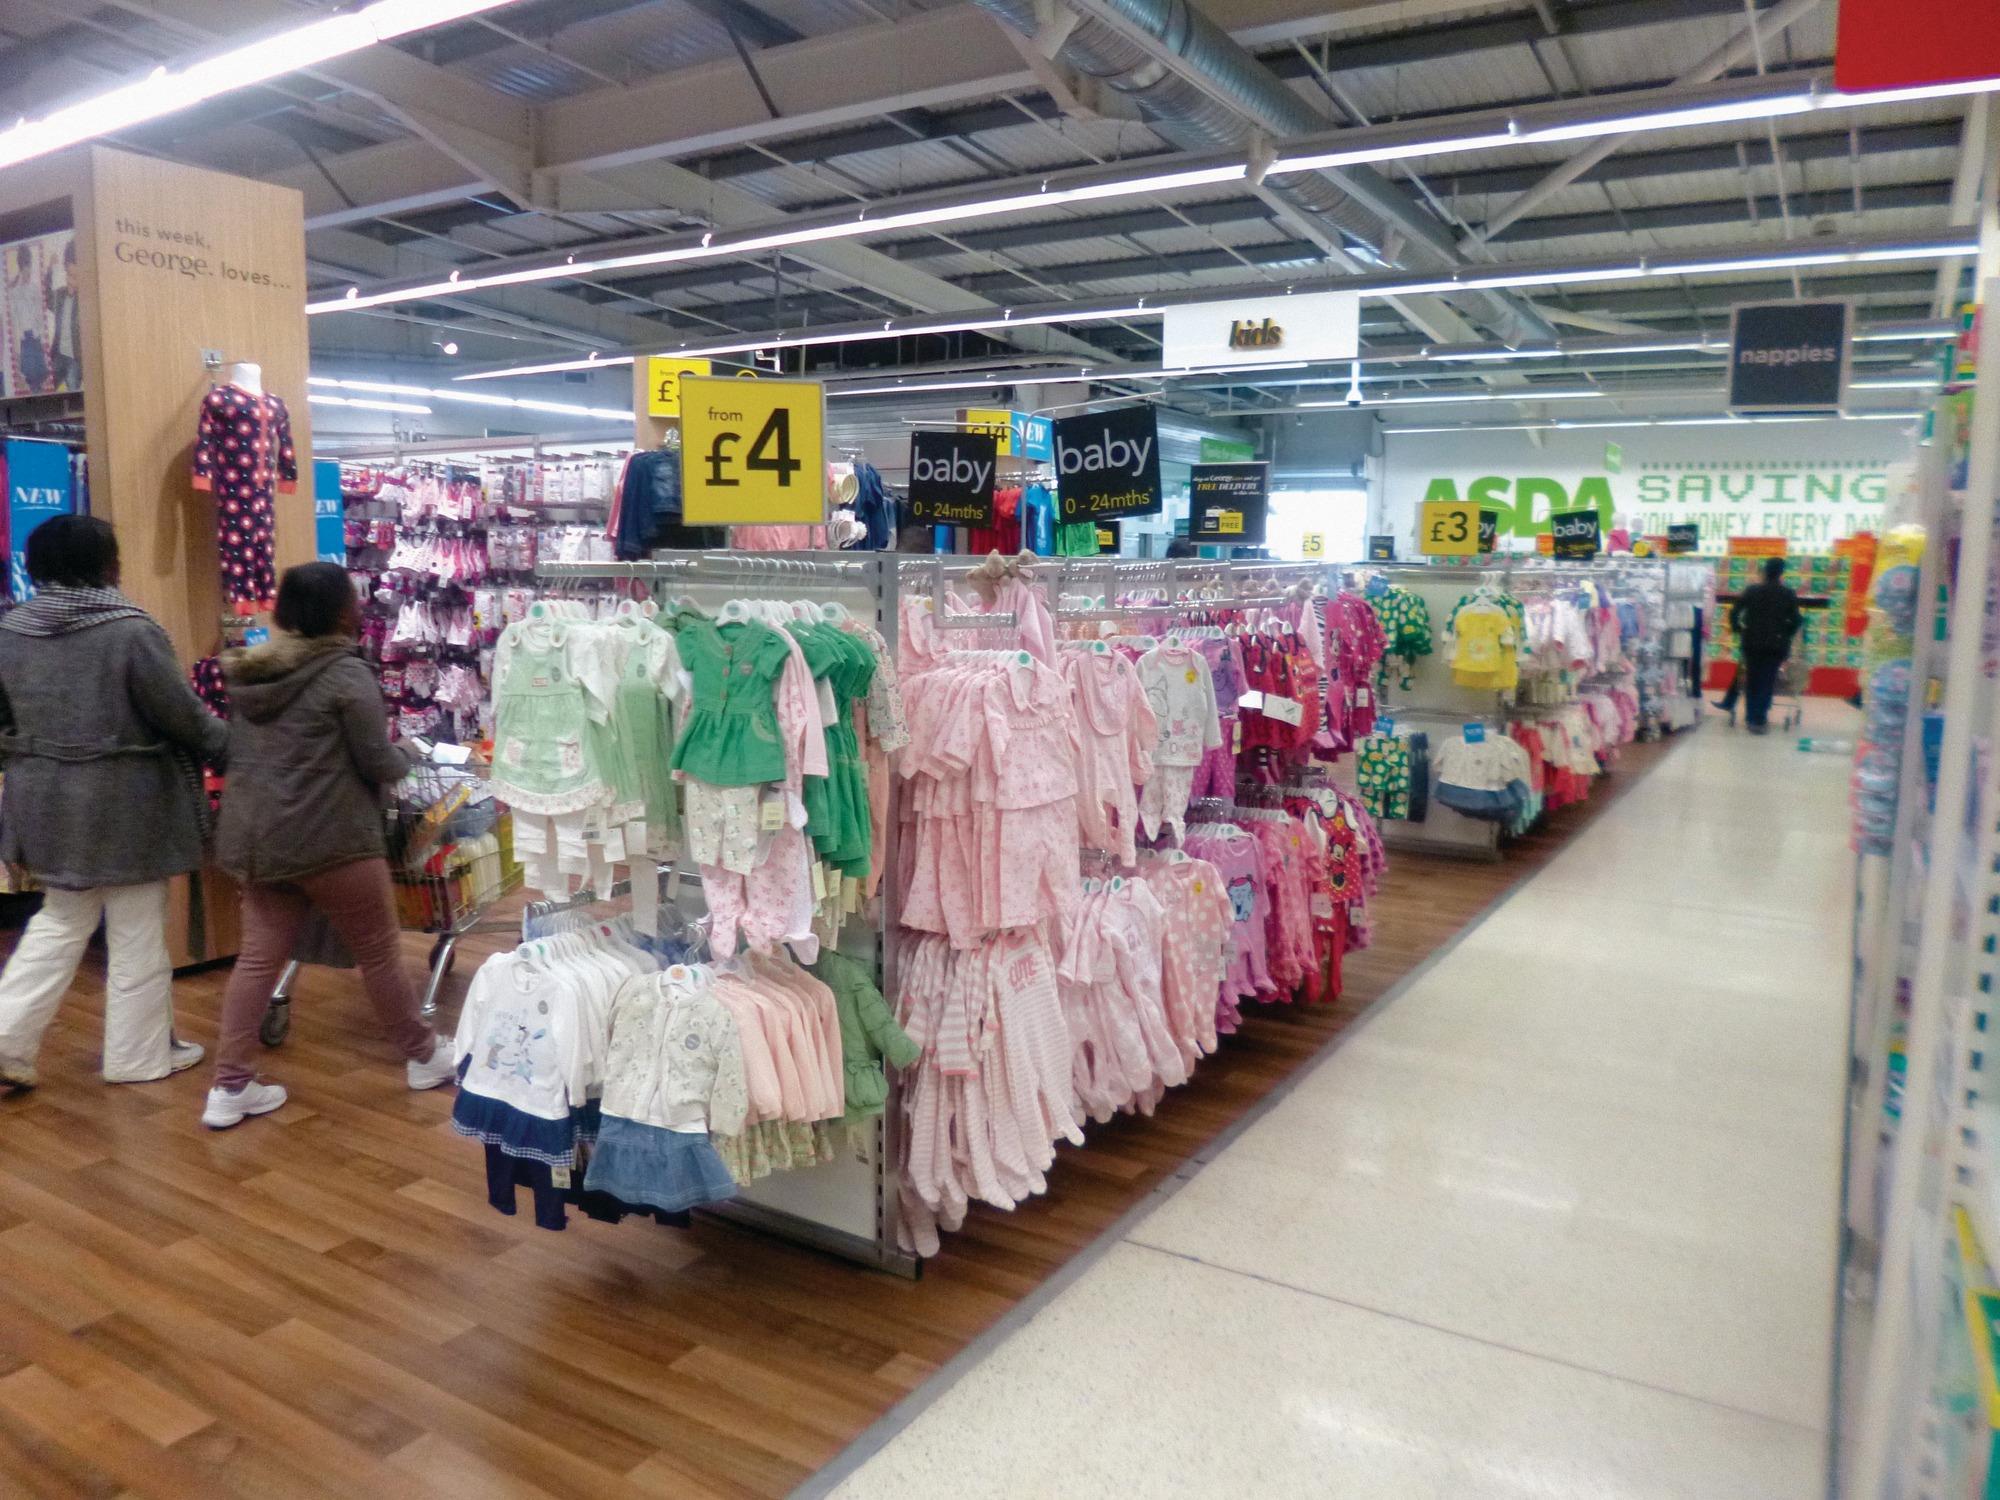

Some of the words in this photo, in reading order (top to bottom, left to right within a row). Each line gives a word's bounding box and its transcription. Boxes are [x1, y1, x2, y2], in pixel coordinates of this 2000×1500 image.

[115, 217, 150, 238] this
[1229, 318, 1282, 347] kids
[1740, 342, 1836, 367] nappies
[709, 407, 743, 422] from
[705, 408, 801, 487] £4
[1057, 428, 1152, 477] baby
[913, 446, 992, 494] baby
[14, 486, 66, 505] NEW
[1637, 474, 1886, 503] SAVING
[315, 500, 339, 513] EW
[914, 501, 923, 516] 0
[1065, 498, 1076, 514] 0
[1431, 511, 1468, 542] £3
[1553, 518, 1597, 538] baby
[1302, 535, 1321, 551] £5
